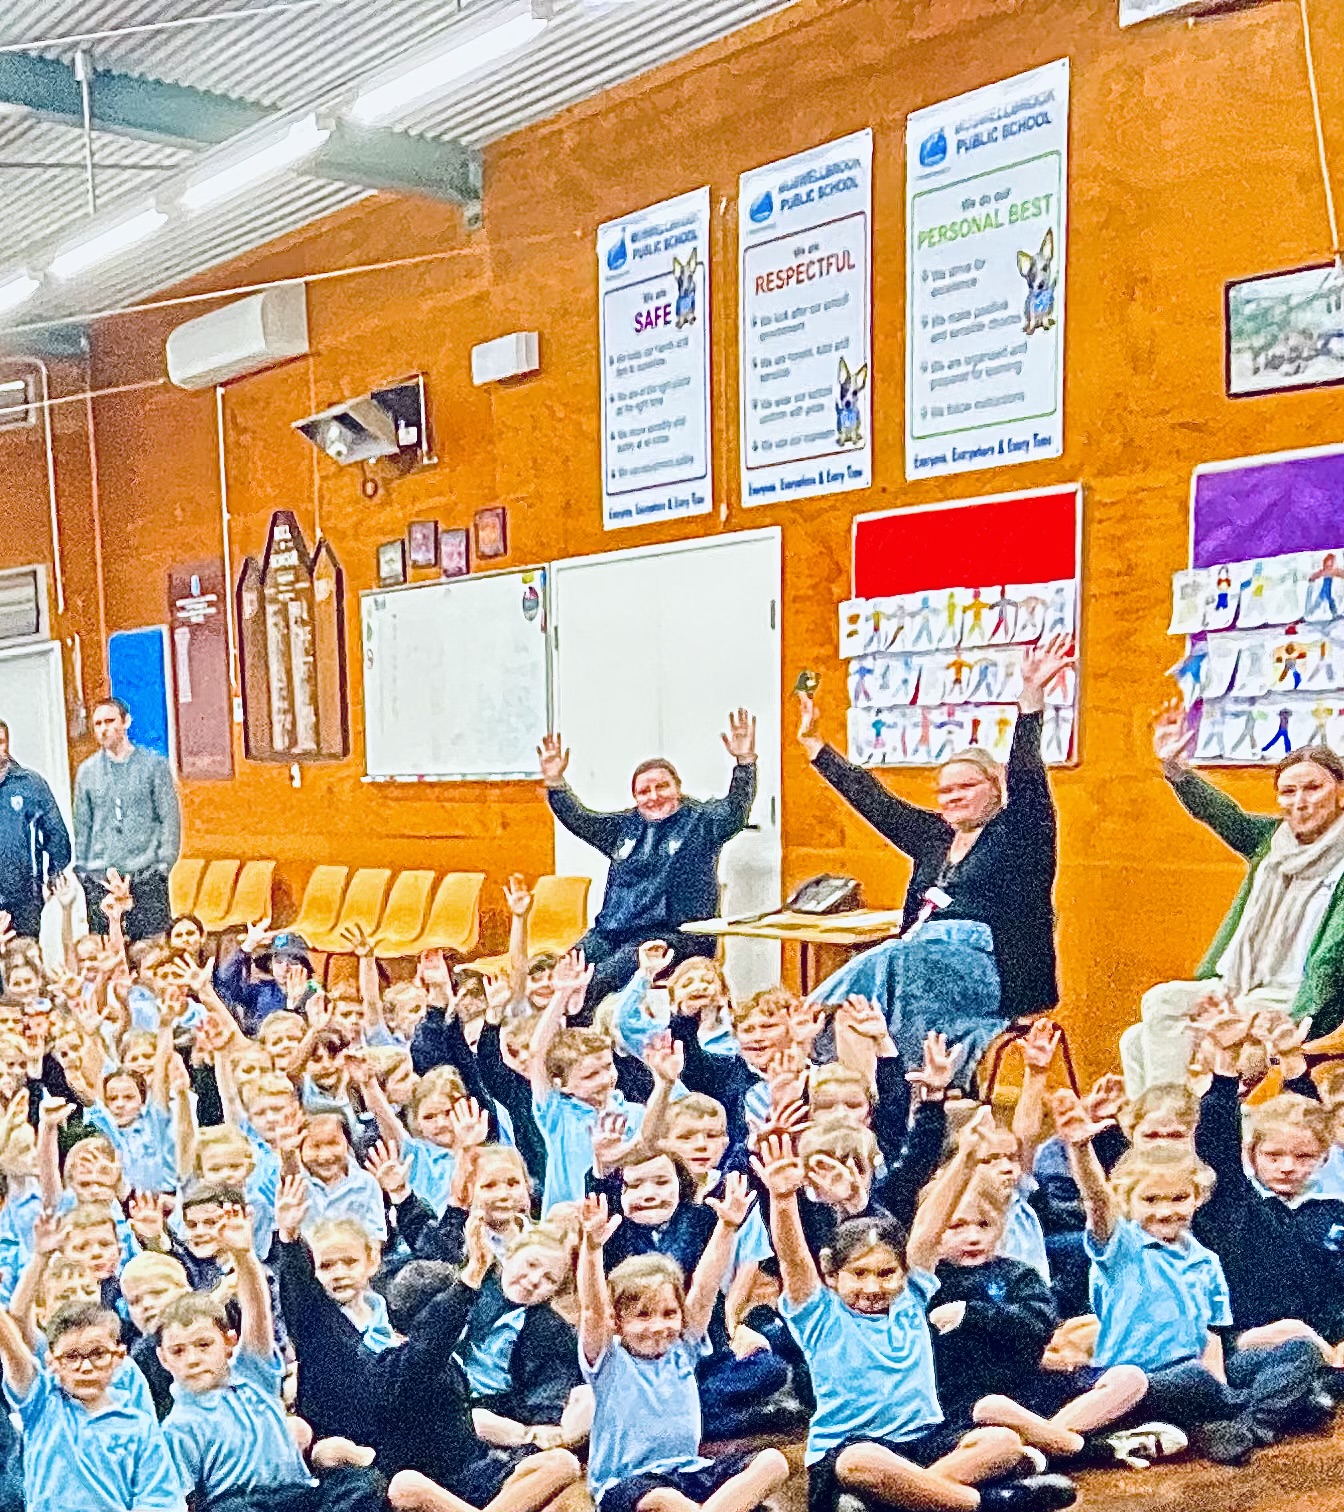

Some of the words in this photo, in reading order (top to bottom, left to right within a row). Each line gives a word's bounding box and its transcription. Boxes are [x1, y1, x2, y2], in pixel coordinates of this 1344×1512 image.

[957, 126, 998, 154] PUBLIC
[1002, 112, 1052, 138] SCHOOL
[780, 188, 814, 211] PUBLIC
[818, 176, 859, 199] SCHOOL
[917, 208, 1005, 249] PERSONAL
[1009, 193, 1053, 224] BEST
[632, 240, 661, 260] PUBLIC
[755, 250, 855, 296] RESPECTFUL
[634, 303, 672, 333] SAFE
